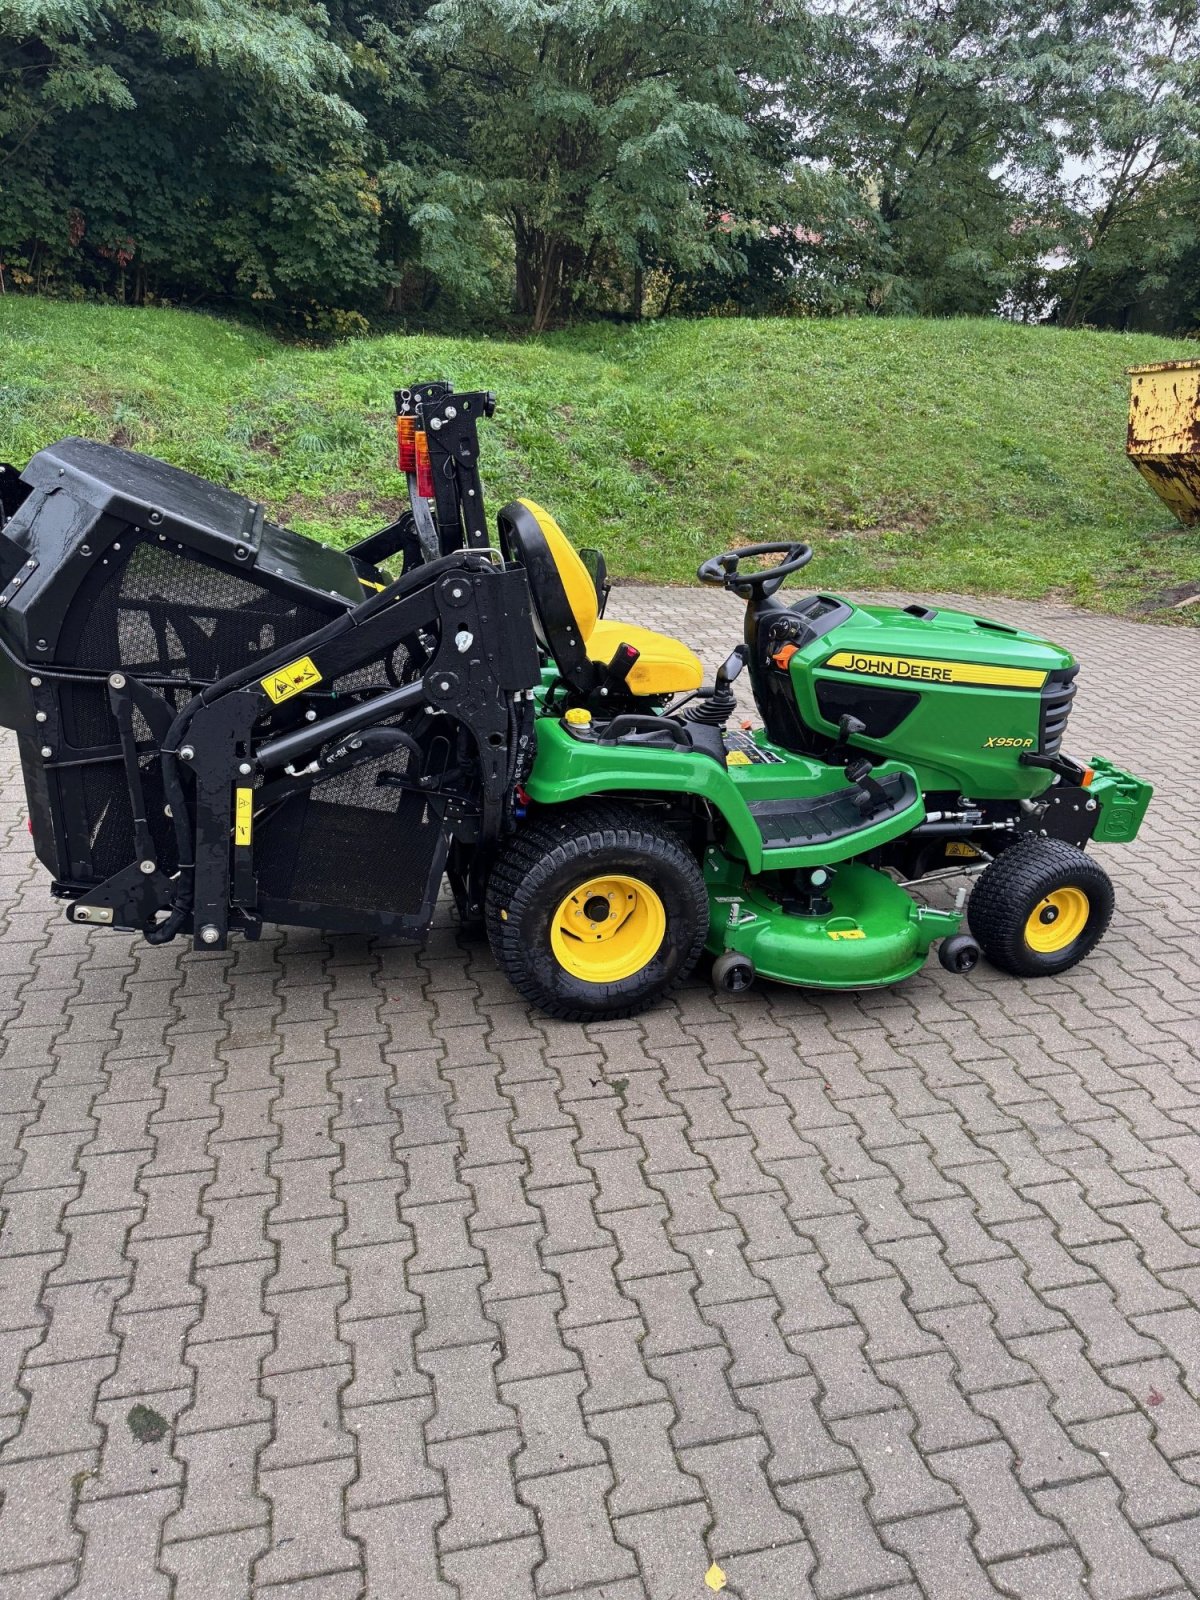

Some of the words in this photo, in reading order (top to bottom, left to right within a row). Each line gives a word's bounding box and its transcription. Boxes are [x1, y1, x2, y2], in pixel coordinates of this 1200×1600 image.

[844, 655, 893, 674] JOHN
[897, 661, 953, 680] DEERE
[982, 737, 1033, 748] X950R
